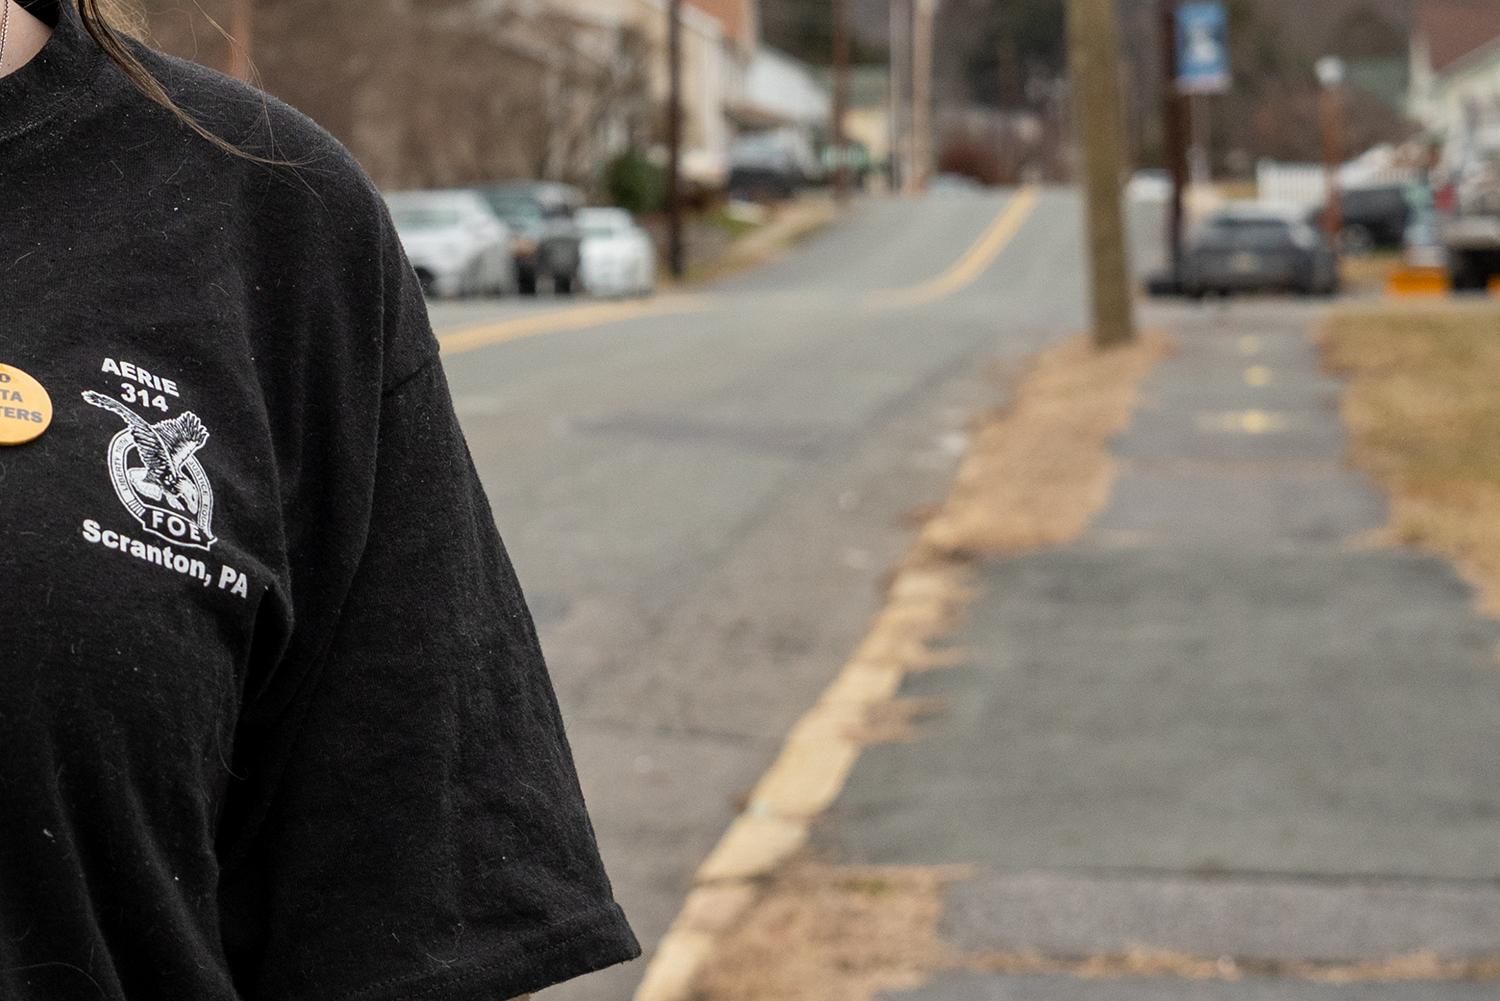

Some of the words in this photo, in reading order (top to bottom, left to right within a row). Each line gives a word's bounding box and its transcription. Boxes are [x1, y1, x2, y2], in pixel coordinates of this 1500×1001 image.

[101, 357, 180, 398] AERIE
[120, 382, 169, 413] 314
[188, 460, 208, 495] JUSTICE
[152, 510, 202, 542] FOE
[82, 518, 212, 587] Scranton,
[218, 564, 248, 599] PA
